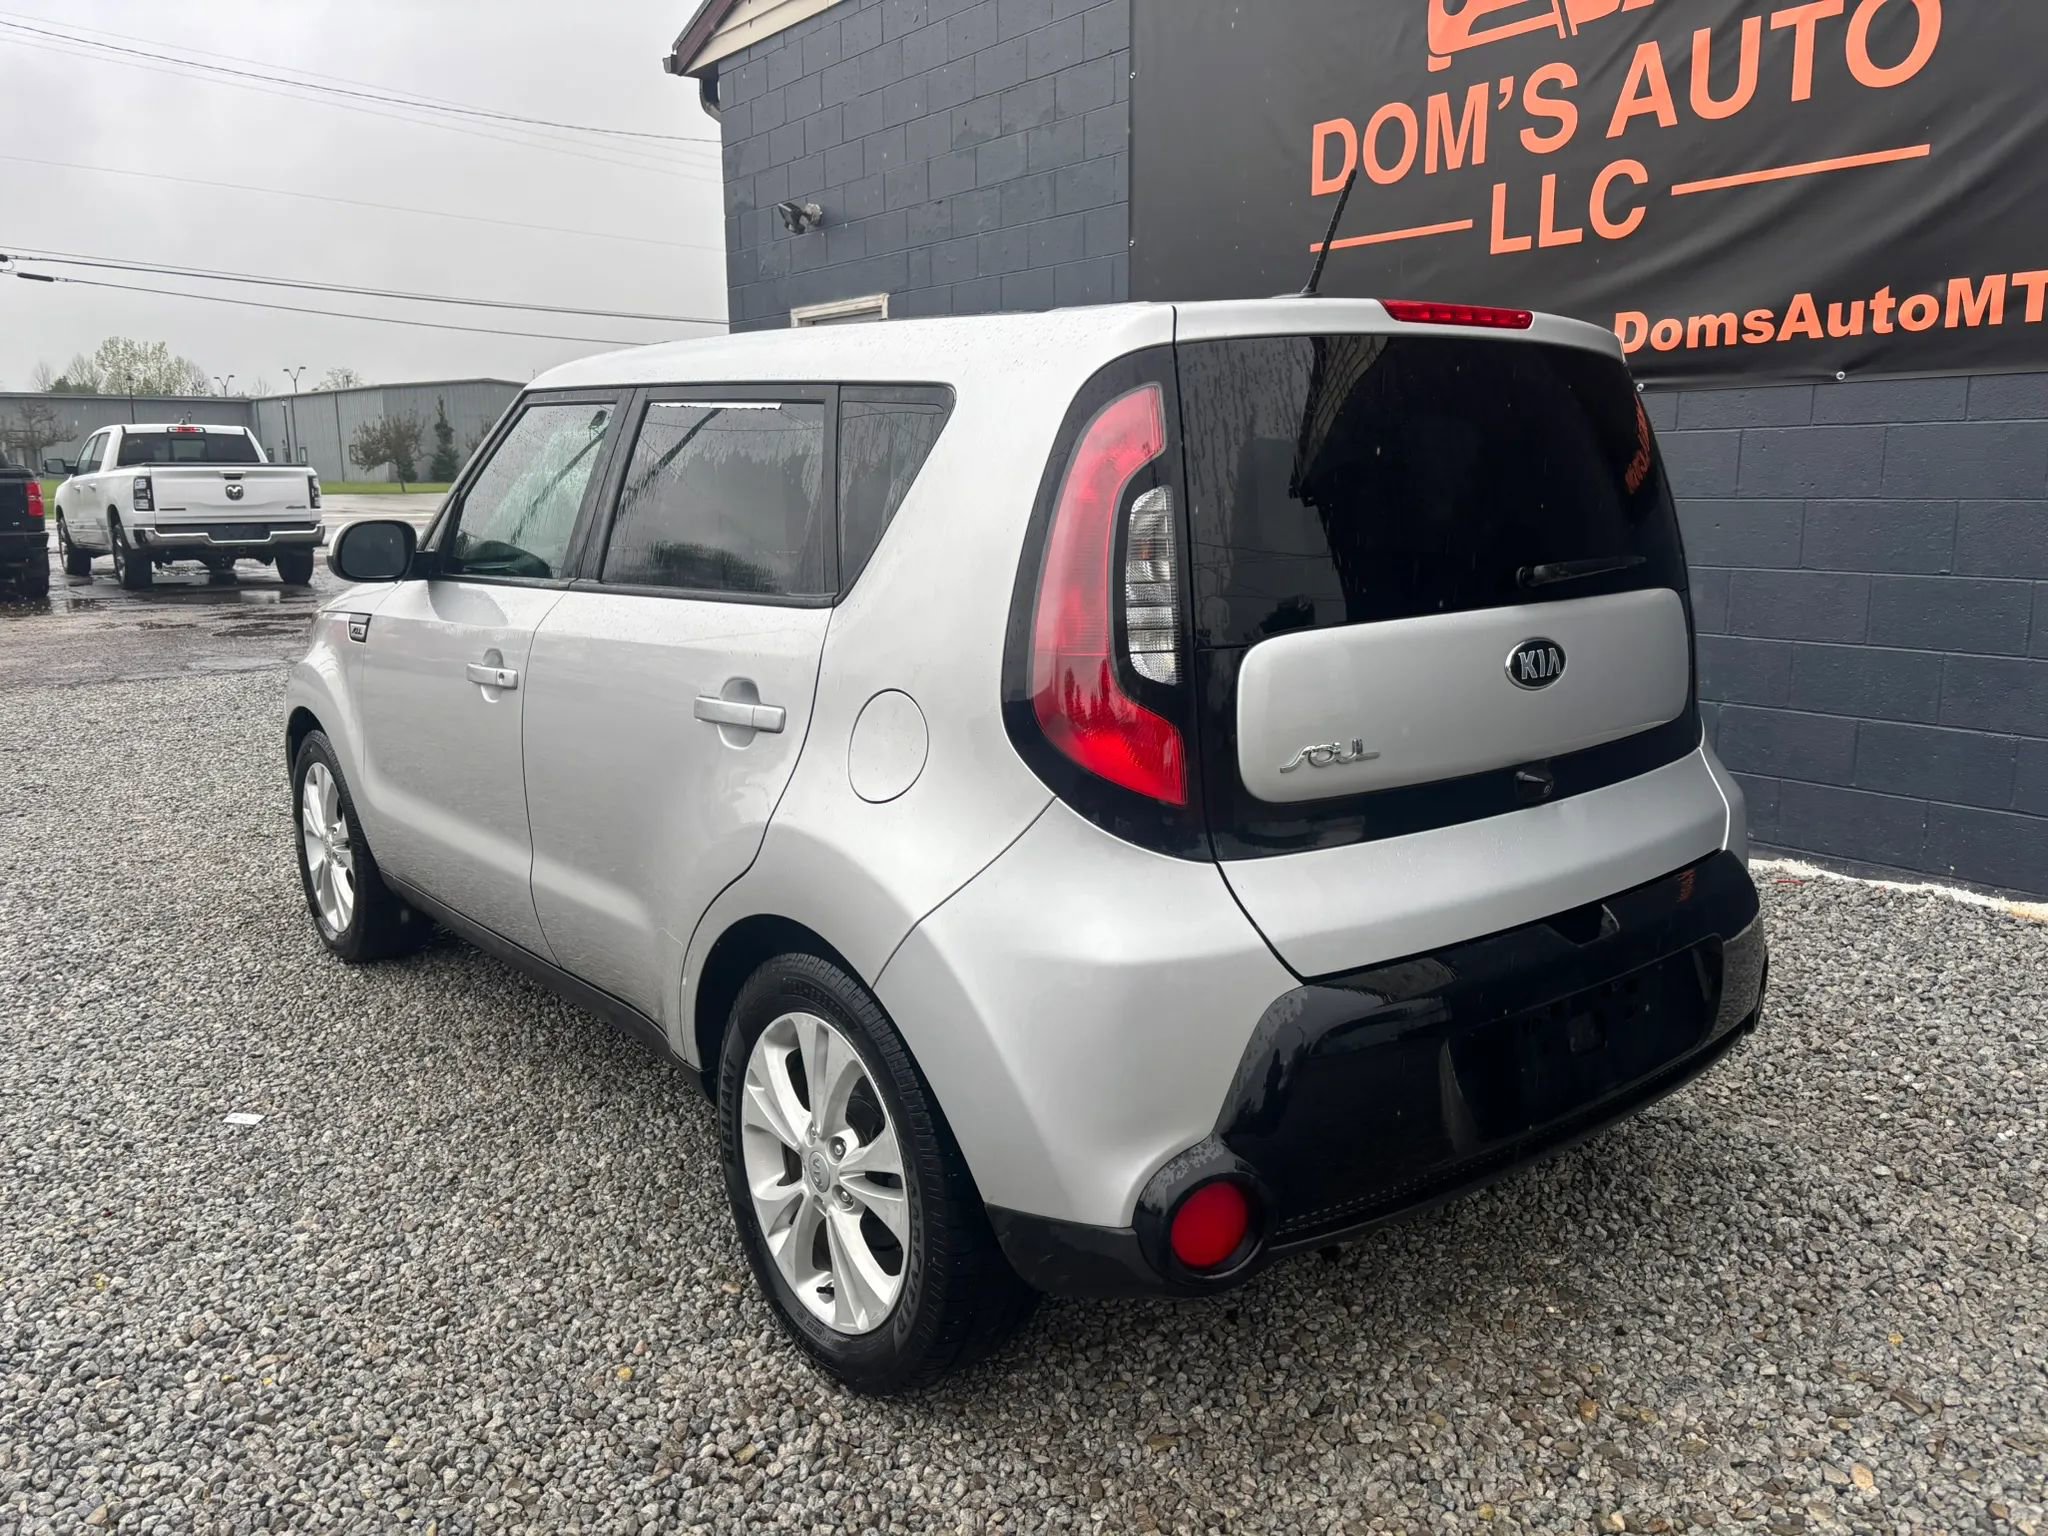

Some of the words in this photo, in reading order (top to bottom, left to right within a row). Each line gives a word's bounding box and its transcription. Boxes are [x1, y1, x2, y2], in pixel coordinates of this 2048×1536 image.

[1311, 64, 1577, 196] DOM'S
[1608, 0, 1941, 138] AUTO
[1491, 160, 1646, 254] LLC
[1614, 269, 2048, 354] DomsAutoMT
[1518, 647, 1561, 680] KIA
[721, 1053, 737, 1164] RELIANT
